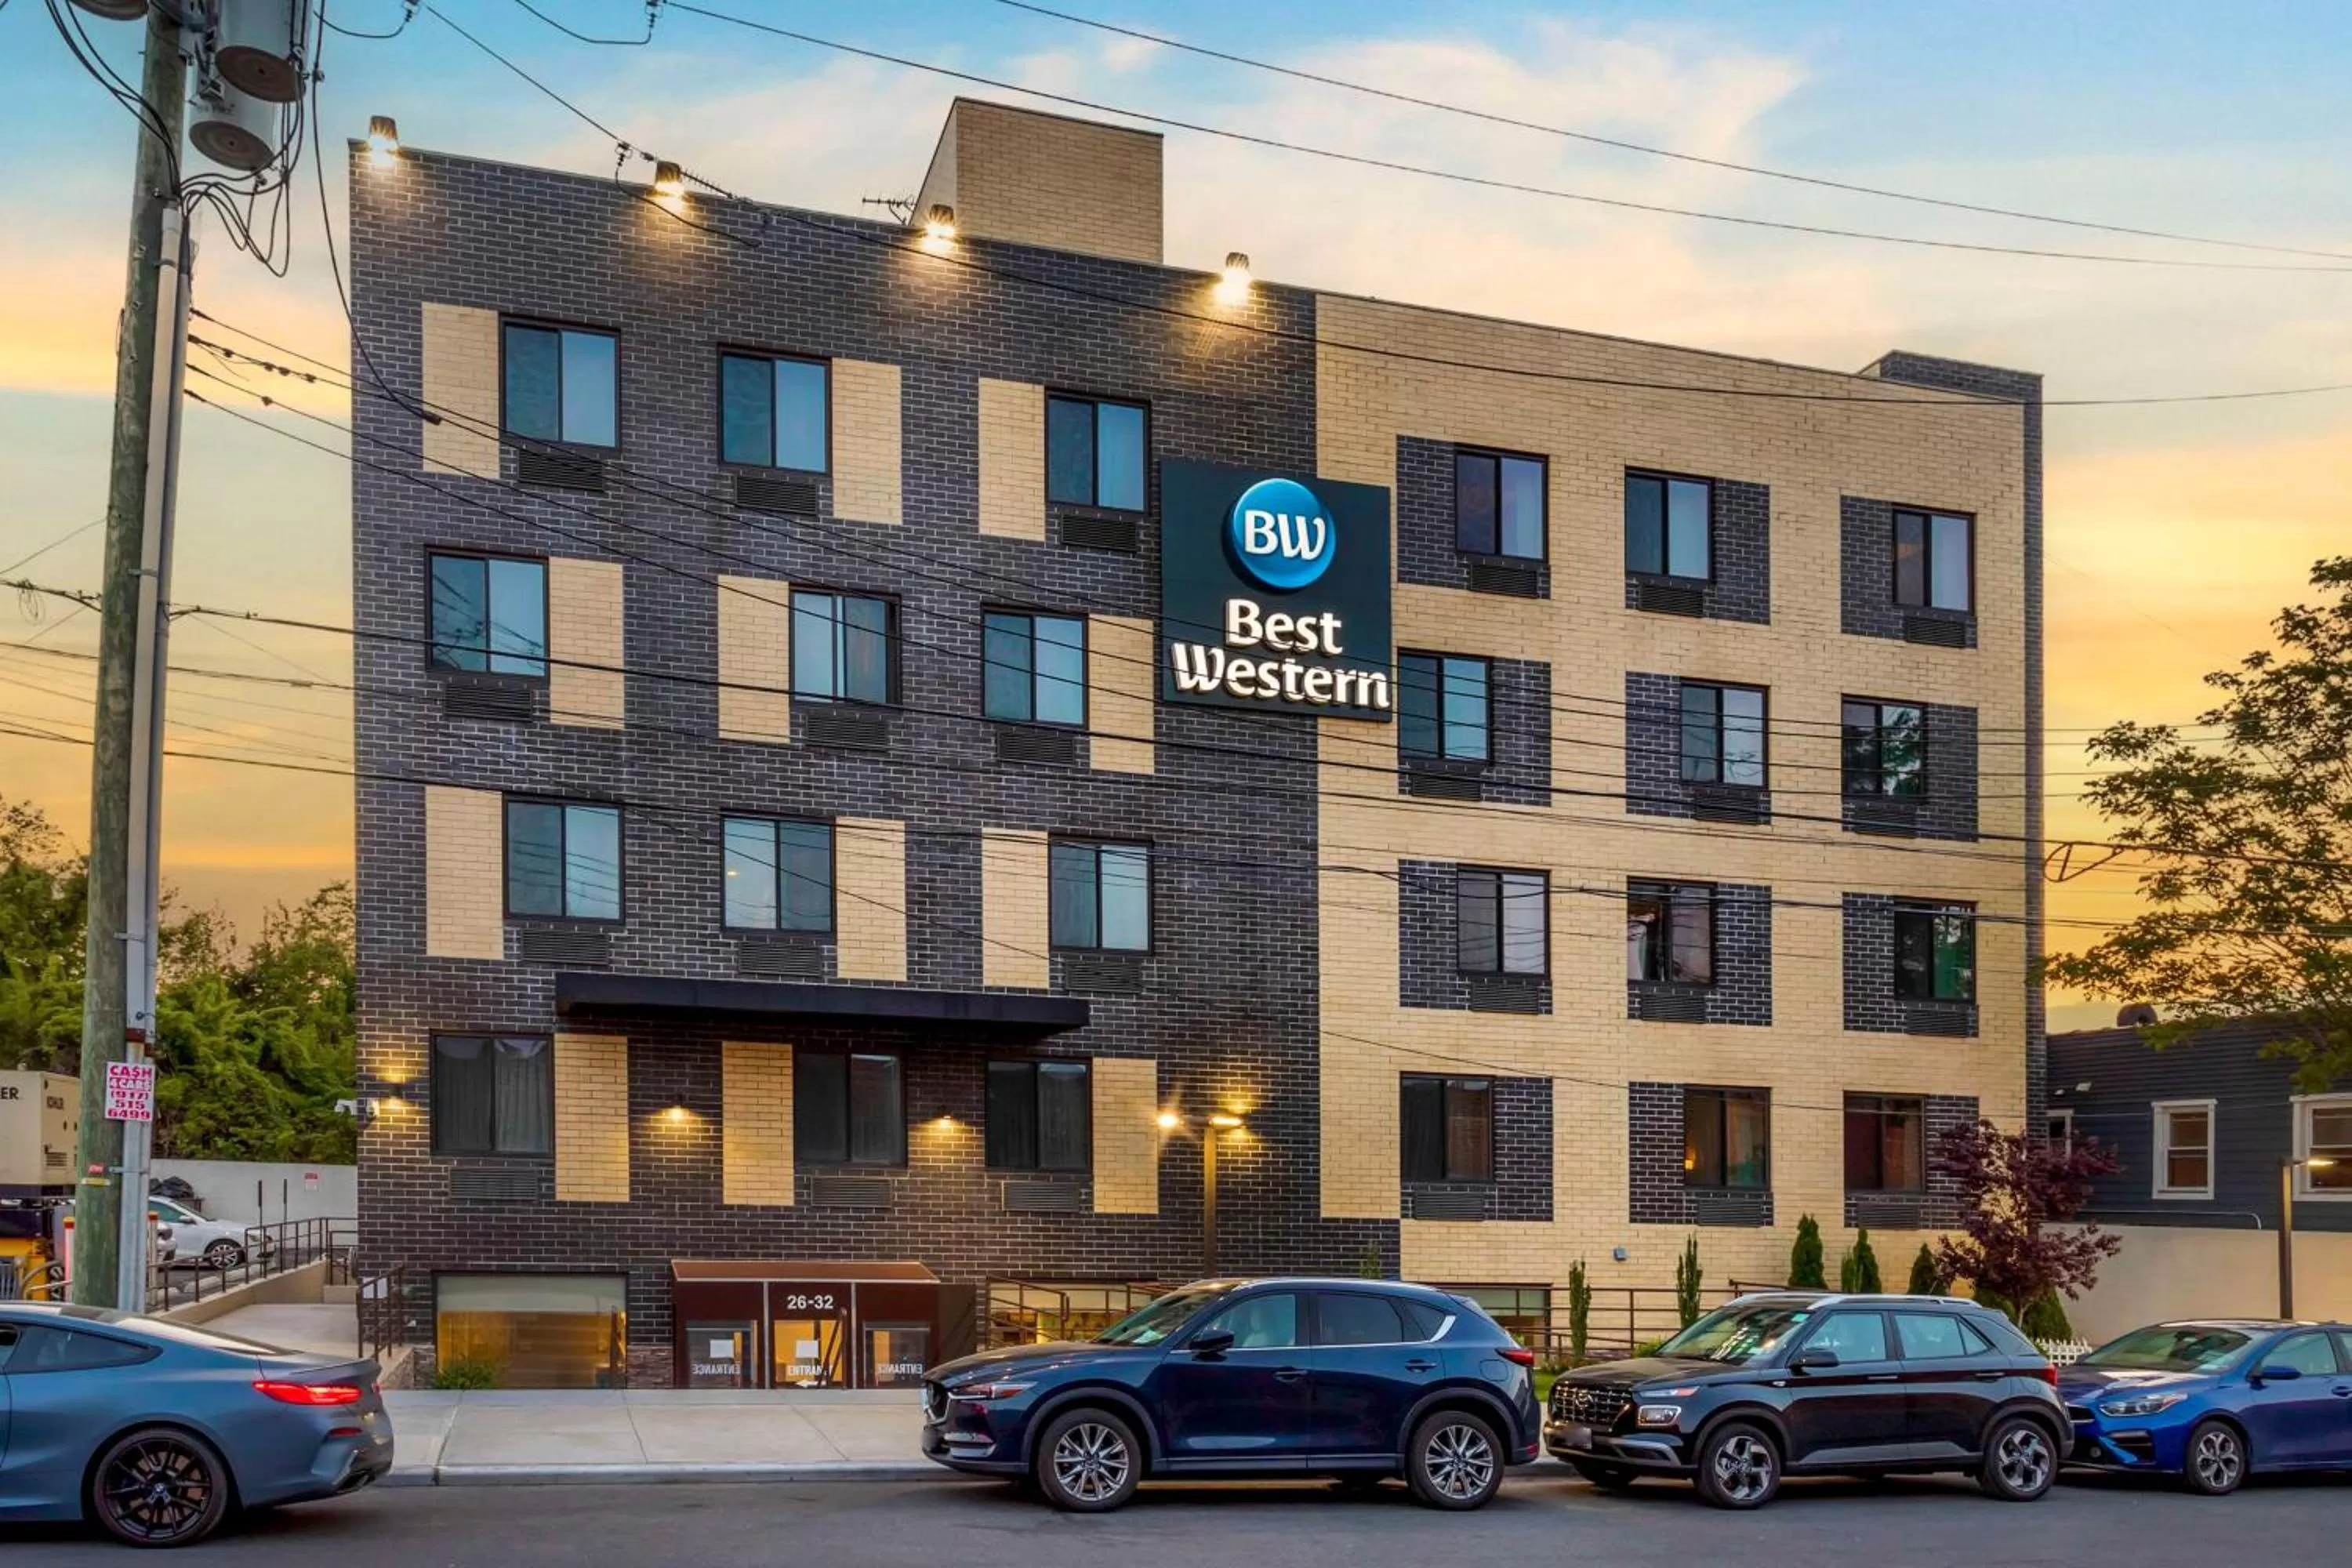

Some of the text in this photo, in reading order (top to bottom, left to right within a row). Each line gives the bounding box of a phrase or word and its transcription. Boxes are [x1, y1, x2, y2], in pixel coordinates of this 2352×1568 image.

[1244, 510, 1326, 561] BW
[1225, 598, 1344, 655] Best
[1171, 642, 1390, 708] Western
[115, 1099, 145, 1109] 515
[786, 1294, 834, 1309] 26-32
